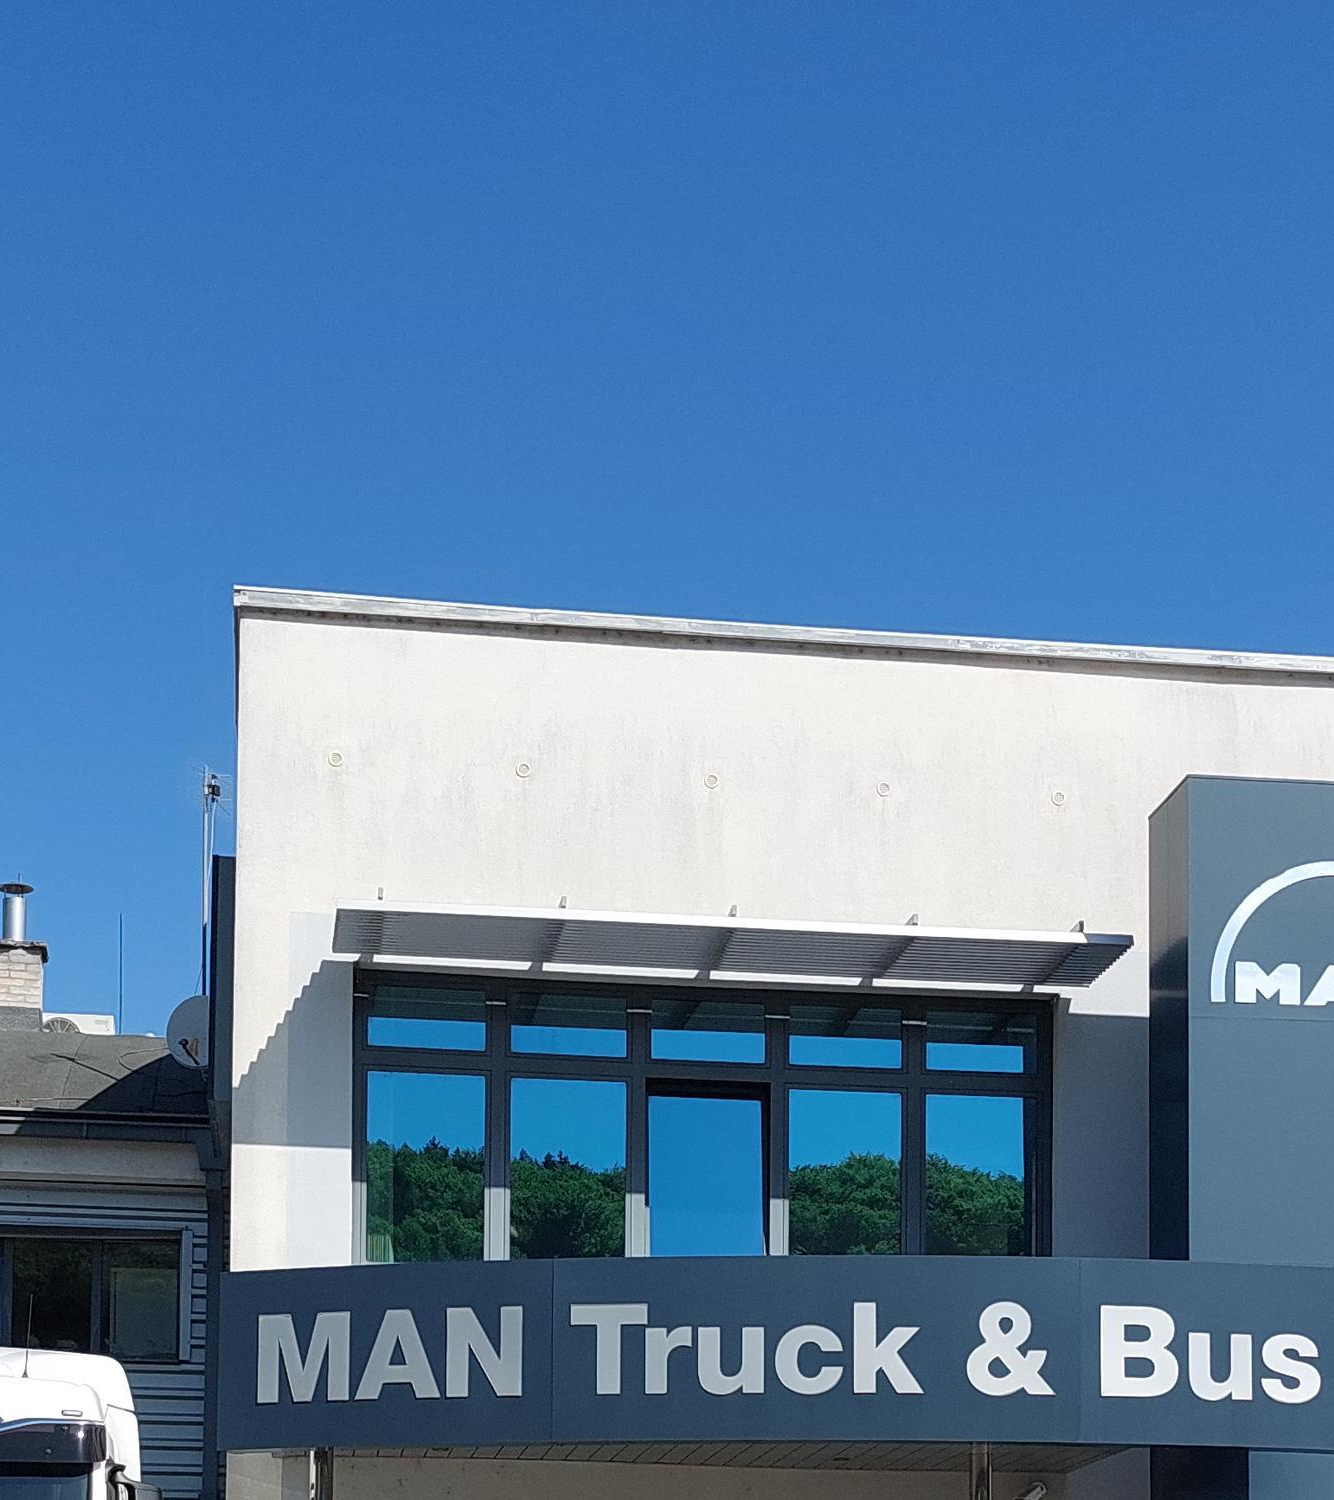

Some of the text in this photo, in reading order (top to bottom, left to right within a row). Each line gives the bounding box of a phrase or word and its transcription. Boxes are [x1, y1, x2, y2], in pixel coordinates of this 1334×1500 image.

[256, 1301, 1323, 1405] MAN Truck & Bus
